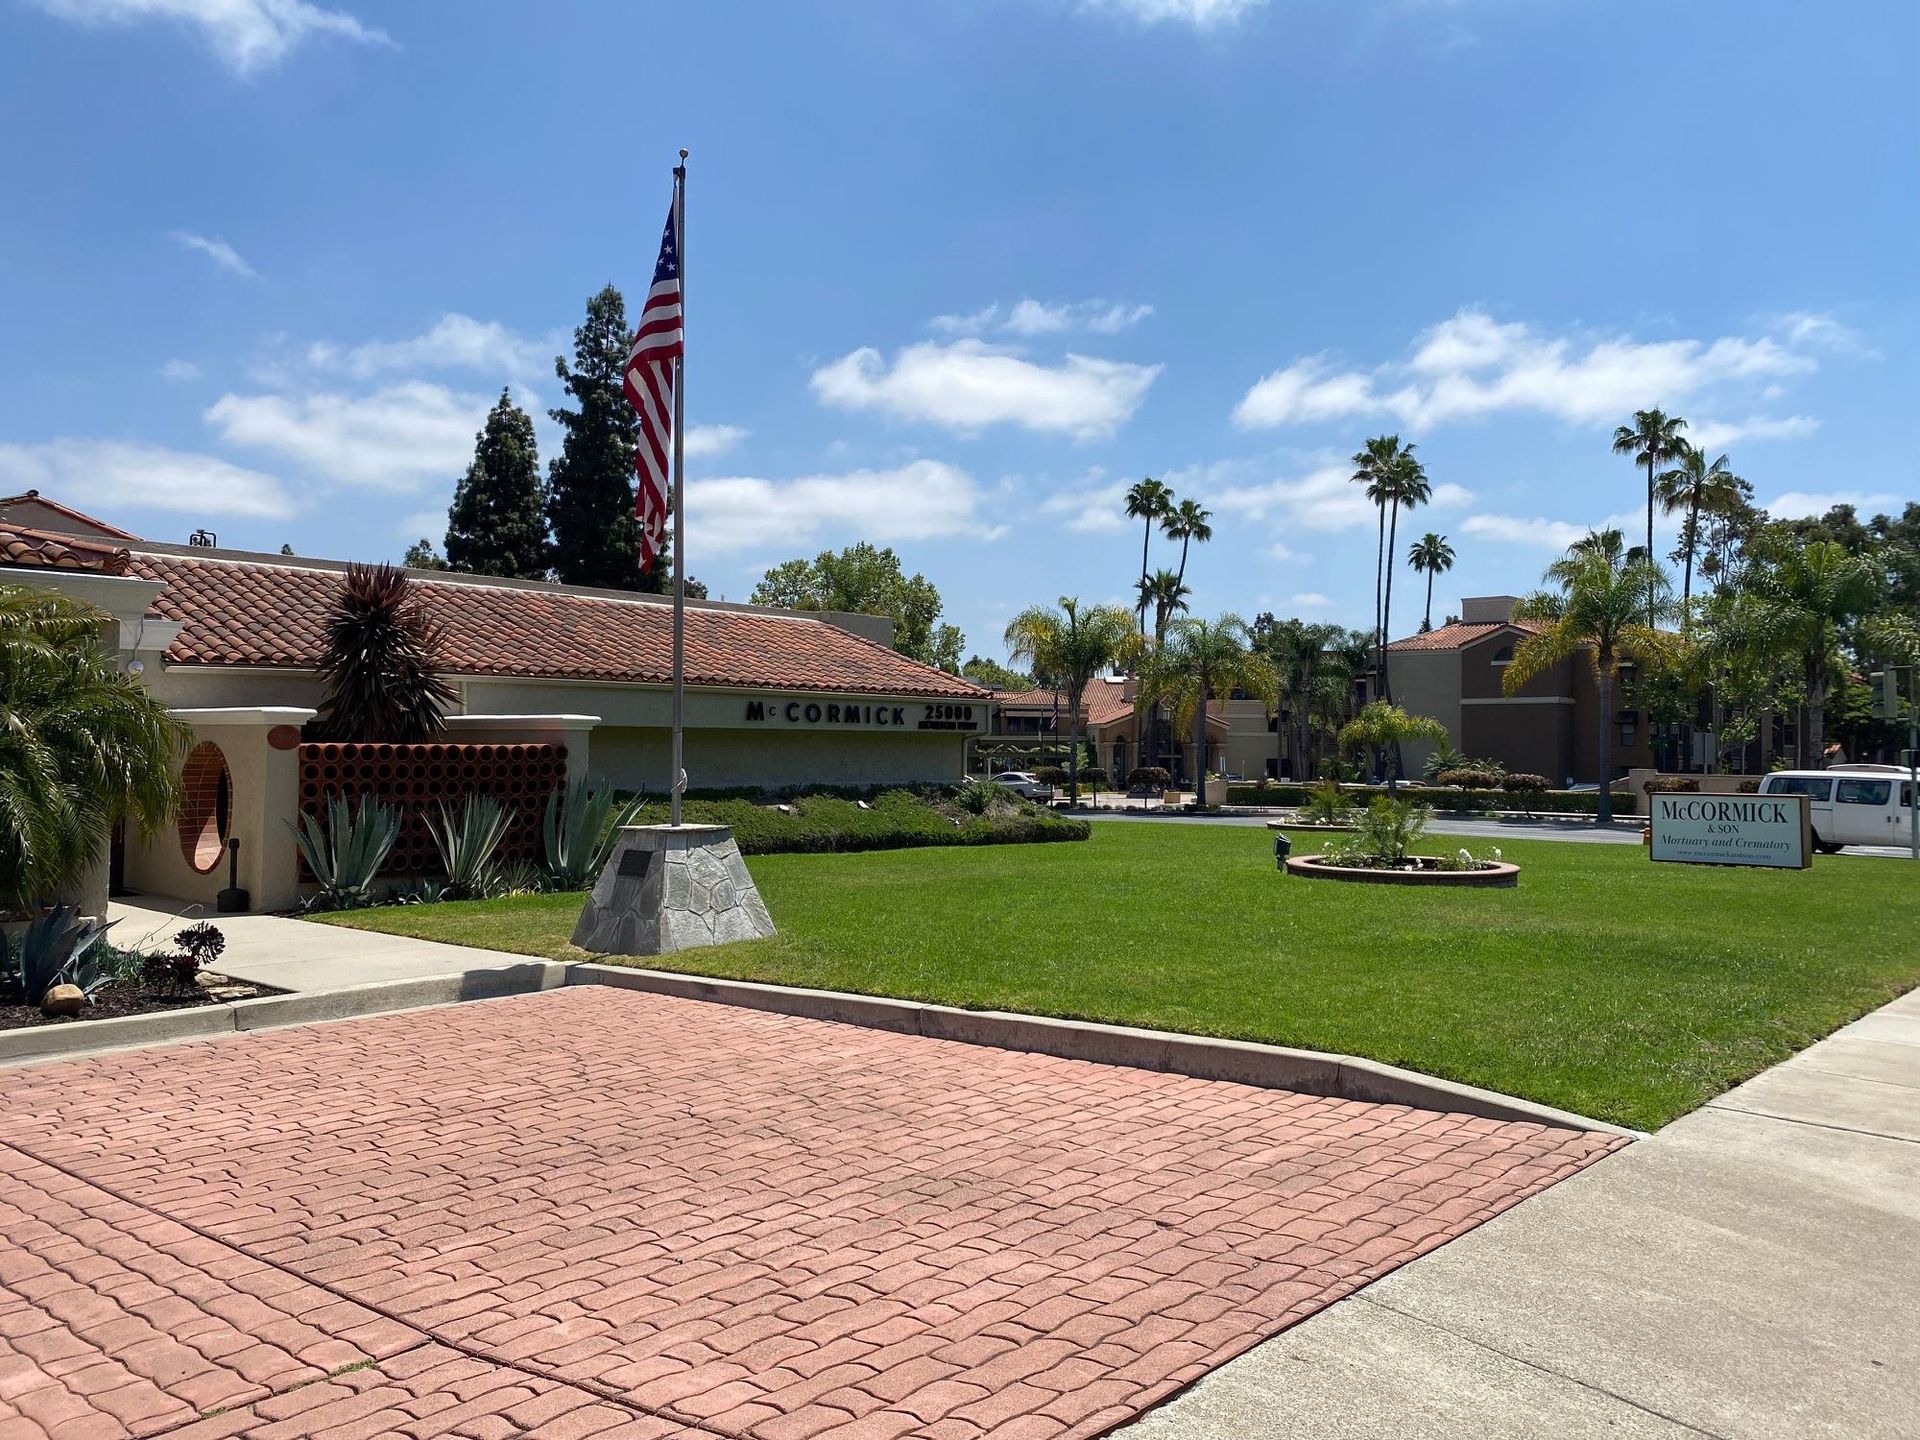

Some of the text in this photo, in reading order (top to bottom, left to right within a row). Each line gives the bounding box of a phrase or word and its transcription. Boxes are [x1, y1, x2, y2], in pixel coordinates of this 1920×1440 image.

[1661, 800, 1788, 824] McCORMICK
[1707, 824, 1740, 834] & SON
[1660, 834, 1792, 853] Mortuary and Crematory
